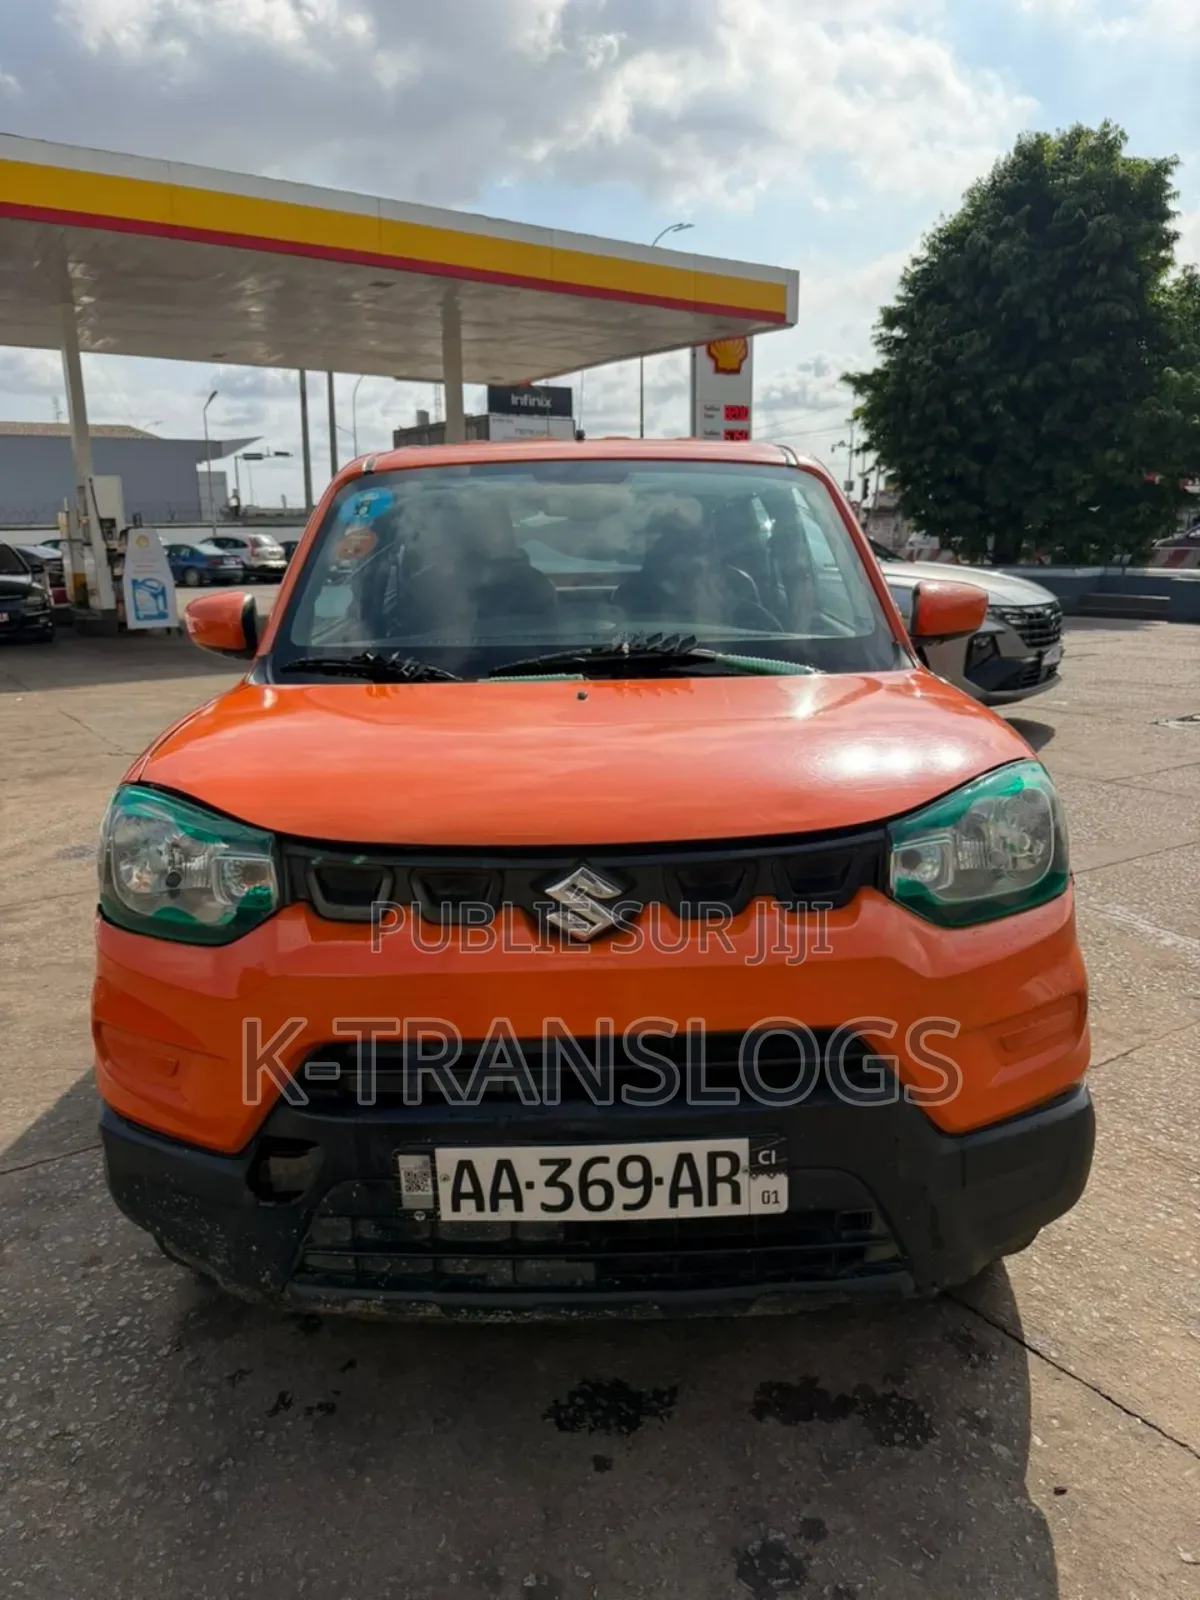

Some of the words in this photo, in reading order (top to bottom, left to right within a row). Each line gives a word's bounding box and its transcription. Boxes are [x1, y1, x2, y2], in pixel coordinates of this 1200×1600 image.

[511, 392, 552, 408] Infinix
[758, 1149, 776, 1165] CI
[761, 1189, 780, 1205] 01
